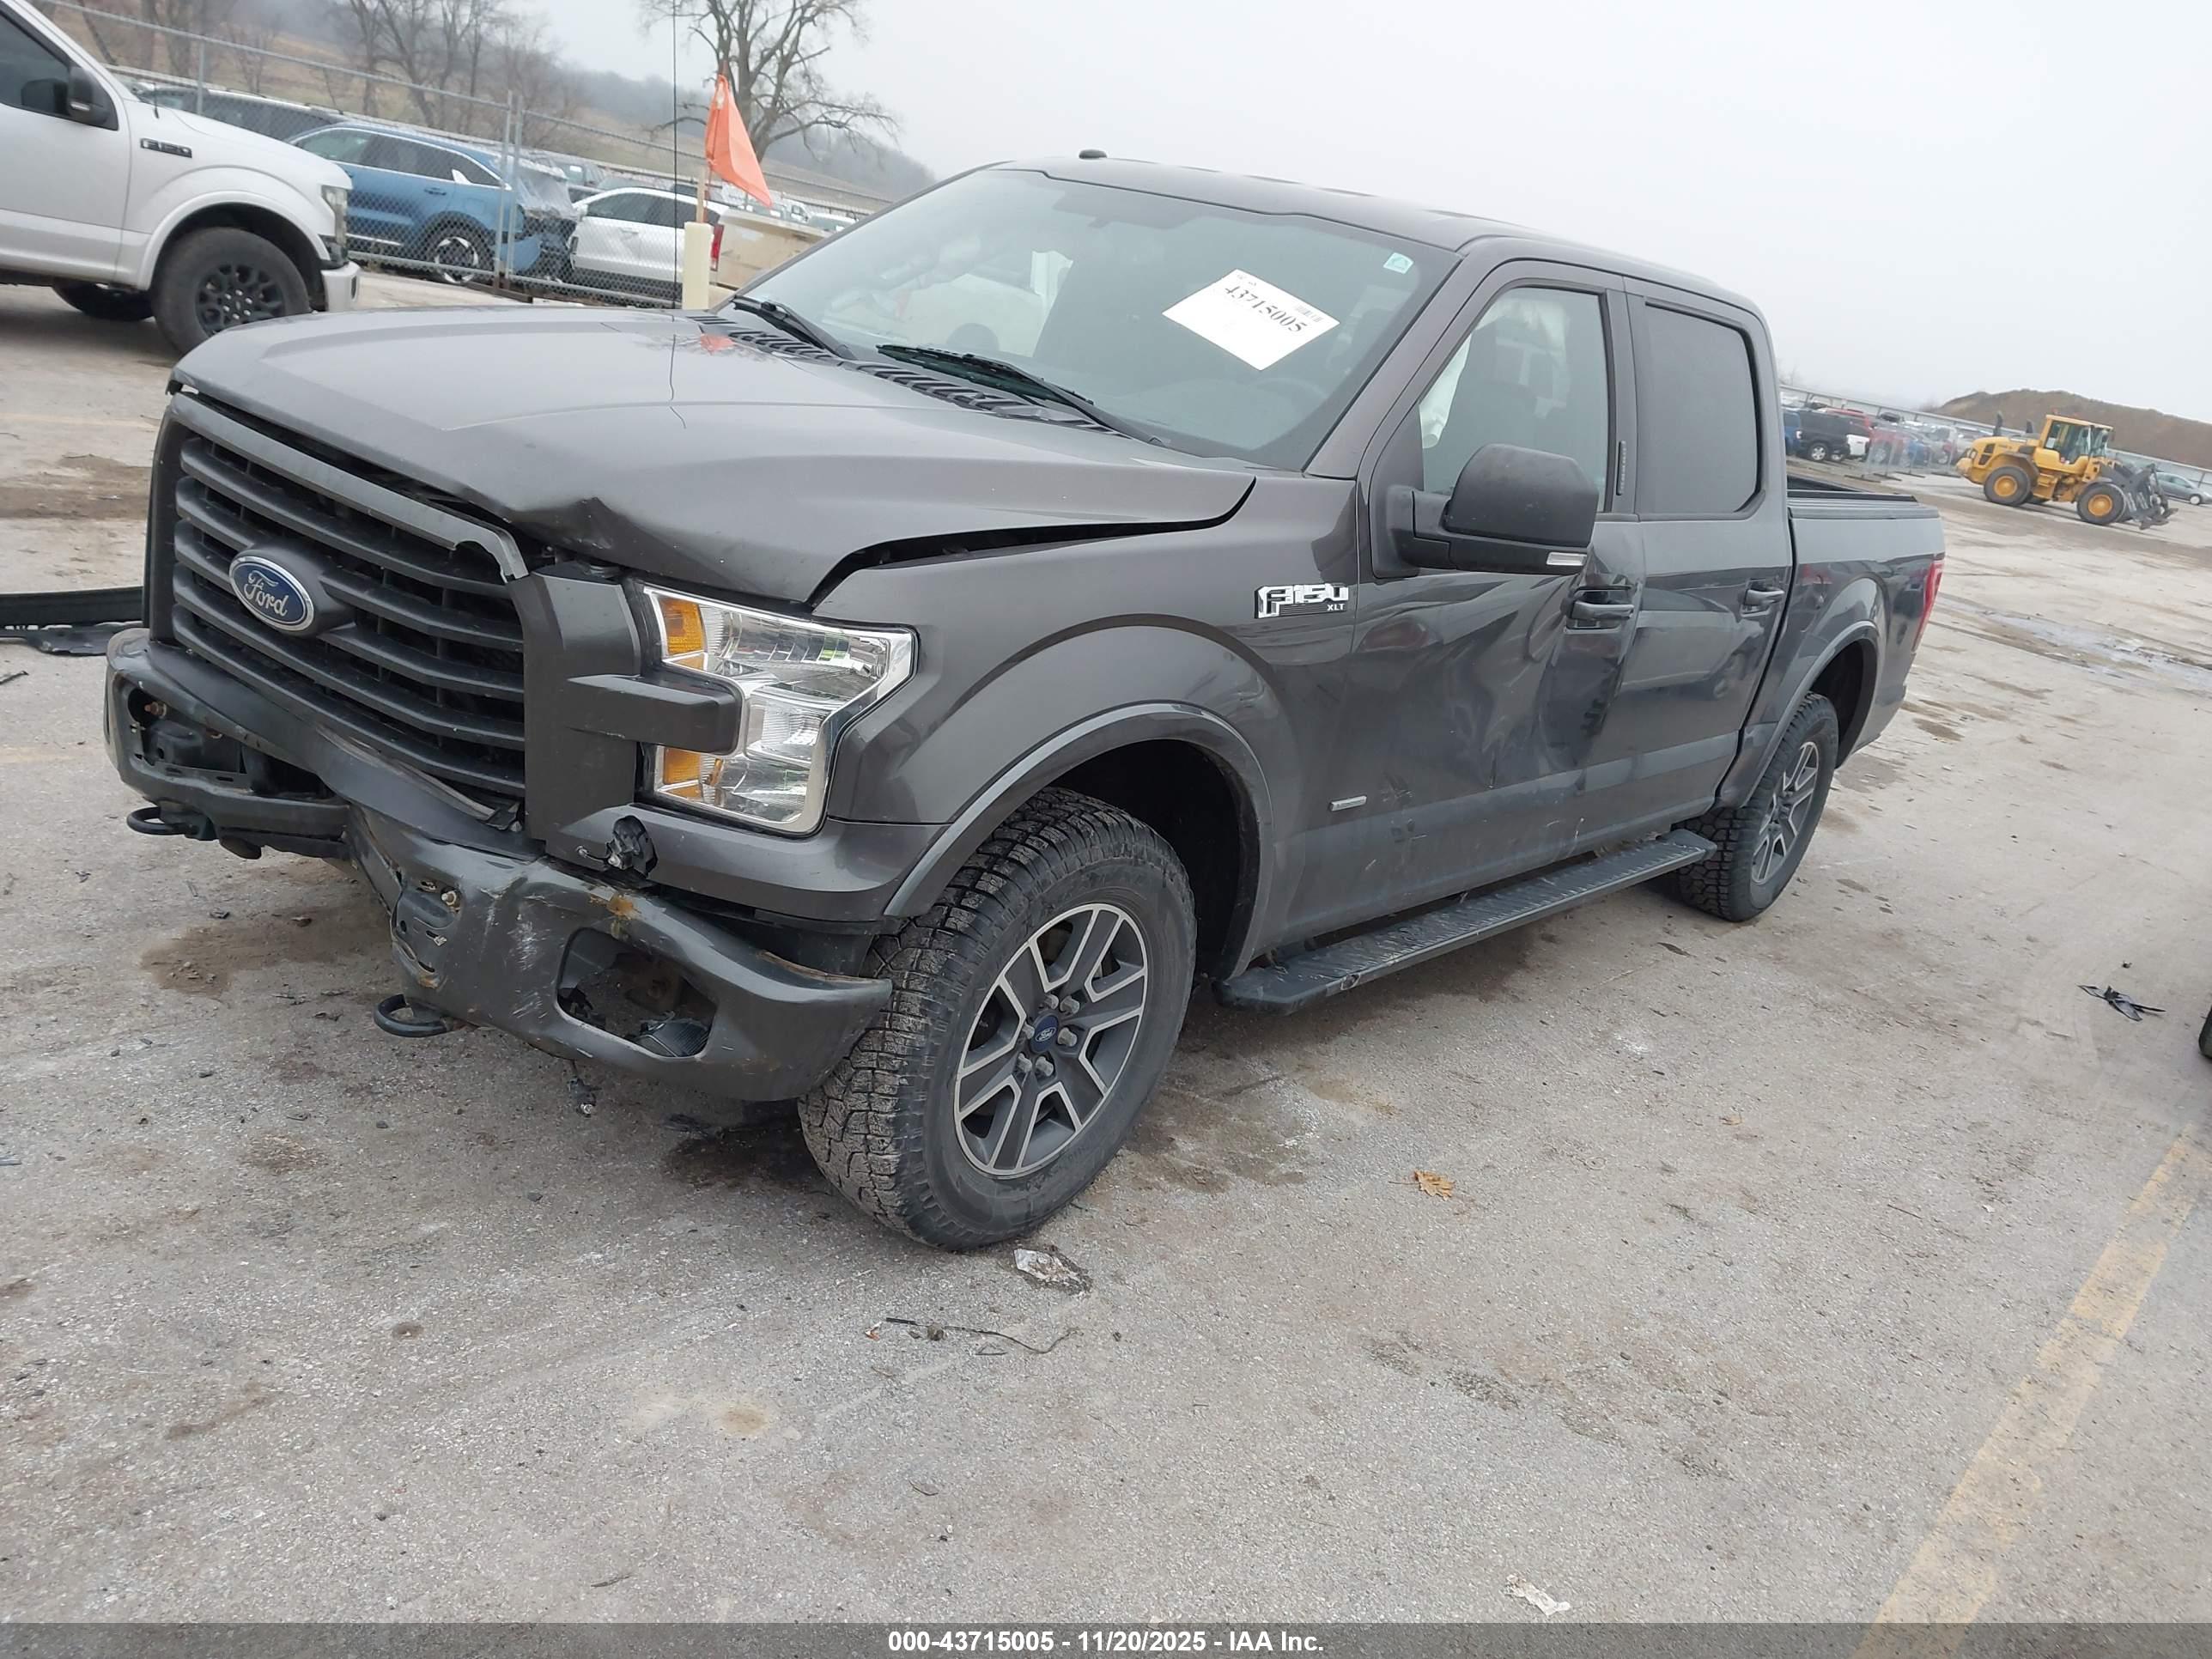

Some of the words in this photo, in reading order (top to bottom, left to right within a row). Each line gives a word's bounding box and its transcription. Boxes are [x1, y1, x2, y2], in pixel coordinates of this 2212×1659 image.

[1224, 285, 1308, 333] 43715005
[244, 570, 289, 617] Ford
[1327, 603, 1346, 611] XLT
